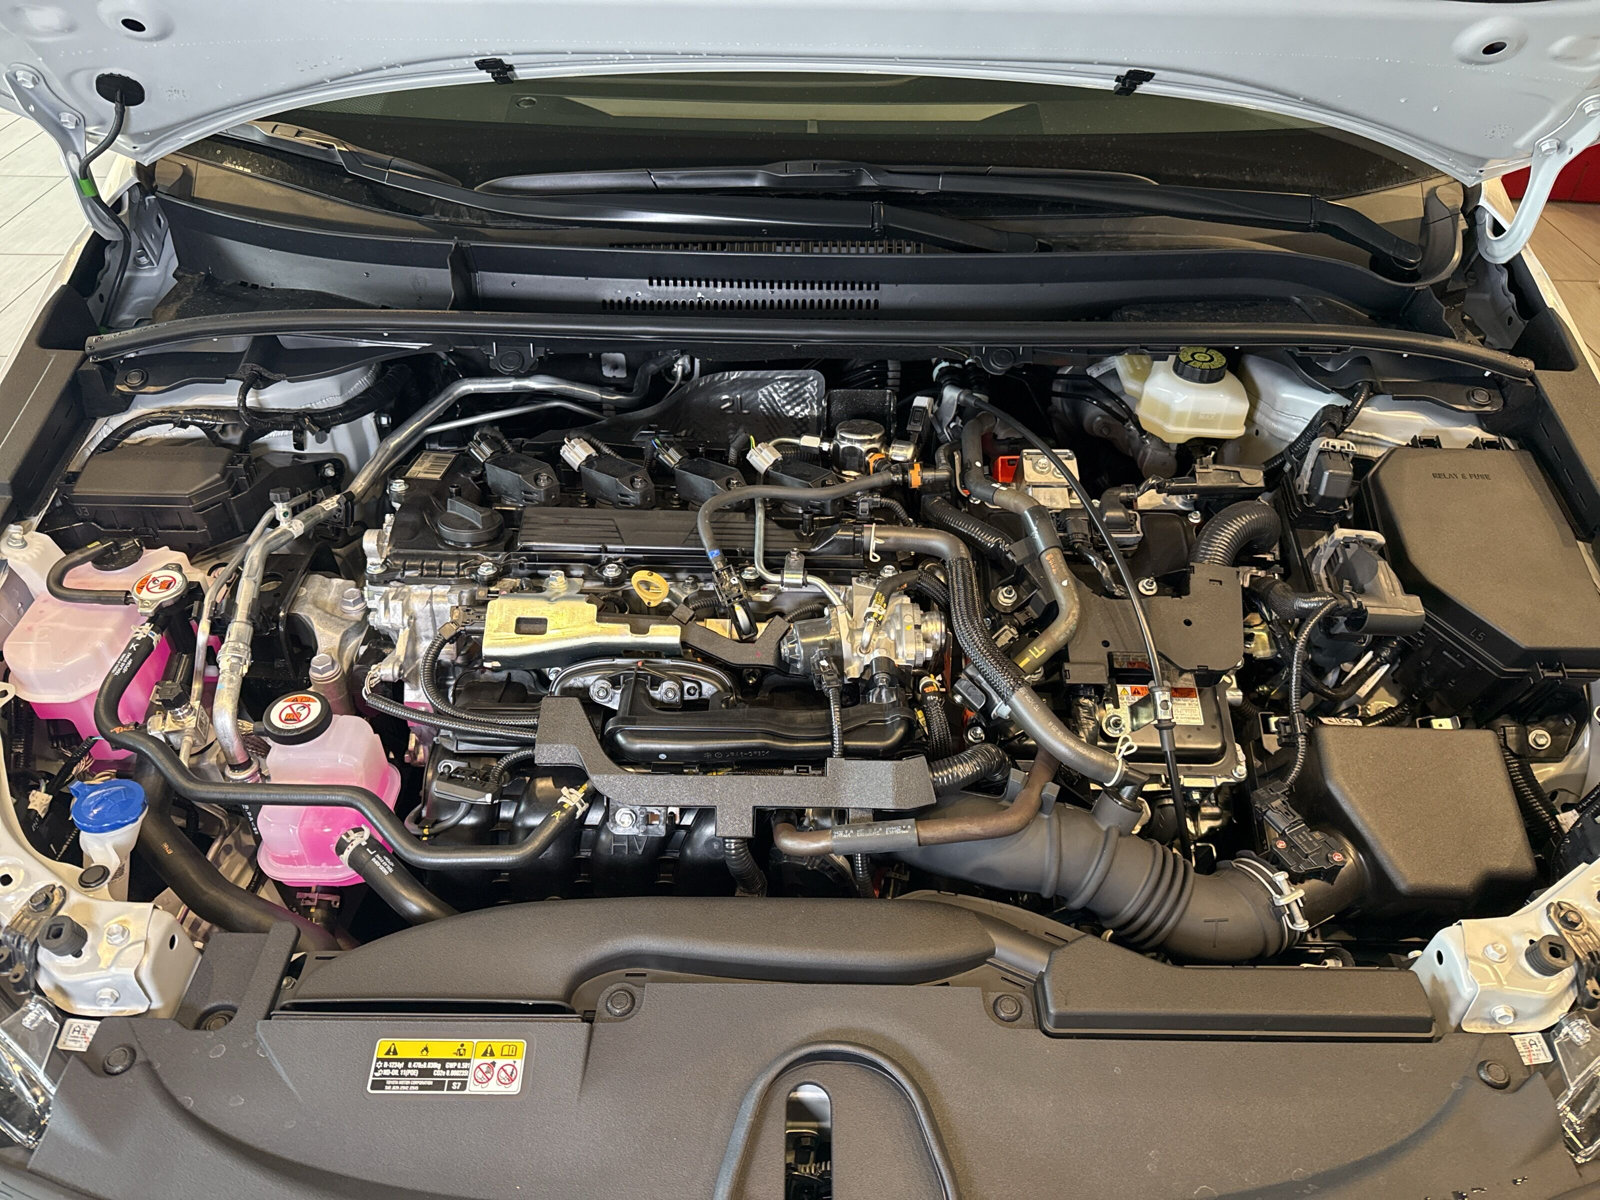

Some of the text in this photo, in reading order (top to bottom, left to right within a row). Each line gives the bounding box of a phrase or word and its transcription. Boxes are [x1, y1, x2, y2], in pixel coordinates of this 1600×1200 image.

[720, 394, 750, 414] 2L
[1432, 472, 1458, 480] RELAY
[129, 642, 140, 651] K
[611, 834, 649, 855] HV
[451, 1081, 462, 1090] S7
